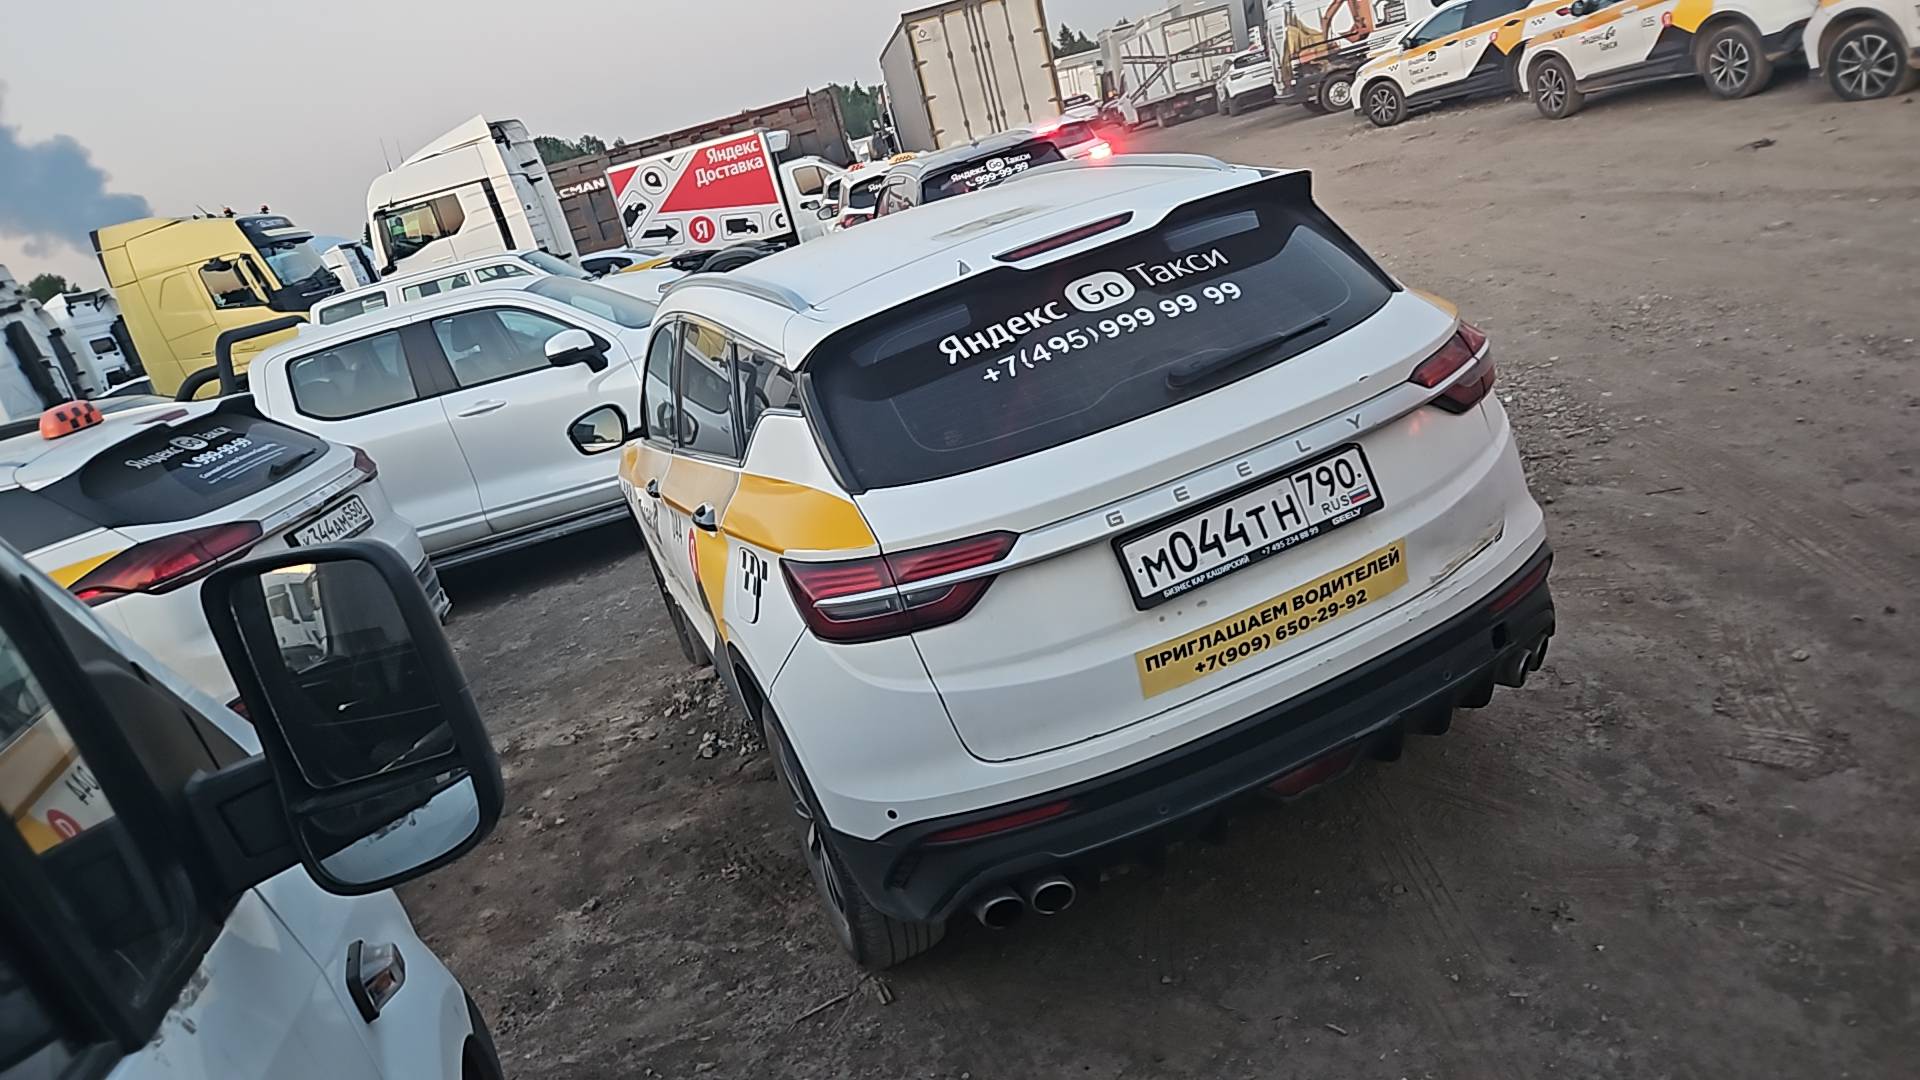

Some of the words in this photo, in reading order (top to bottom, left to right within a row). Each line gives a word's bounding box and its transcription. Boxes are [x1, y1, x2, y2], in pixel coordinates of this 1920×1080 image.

[706, 139, 760, 165] Яндекс
[695, 155, 765, 188] Доставка
[951, 166, 987, 182] Яндекс
[1003, 153, 1031, 164] Такси
[975, 161, 1029, 184] 999-99-99
[696, 220, 709, 240] Я
[939, 301, 1069, 365] Яндекс
[1077, 283, 1124, 305] Go
[1127, 249, 1230, 287] Такси
[1159, 293, 1198, 319] 99
[1202, 281, 1242, 306] 99
[125, 445, 184, 470] Яндекс
[194, 438, 253, 466] 999-99-99
[1105, 414, 1362, 527] GEELY
[1321, 495, 1350, 517] RUS
[1331, 507, 1362, 526] GEELY
[1141, 493, 1301, 588] М044ТН
[1295, 458, 1356, 505] 790
[1261, 546, 1271, 557] +7
[1271, 540, 1285, 552] 495
[1285, 534, 1299, 546] 234
[1163, 580, 1192, 598] БИЗНЕС
[1191, 573, 1206, 587] КАР
[1206, 554, 1250, 579] КАШИРСКИЙ
[1145, 601, 1288, 672] ПРИГЛАШАЕМ
[1292, 547, 1400, 612] ВОДИТЕЛЕЙ
[1195, 633, 1271, 674] +7(909)
[1275, 589, 1368, 641] 650-29-92
